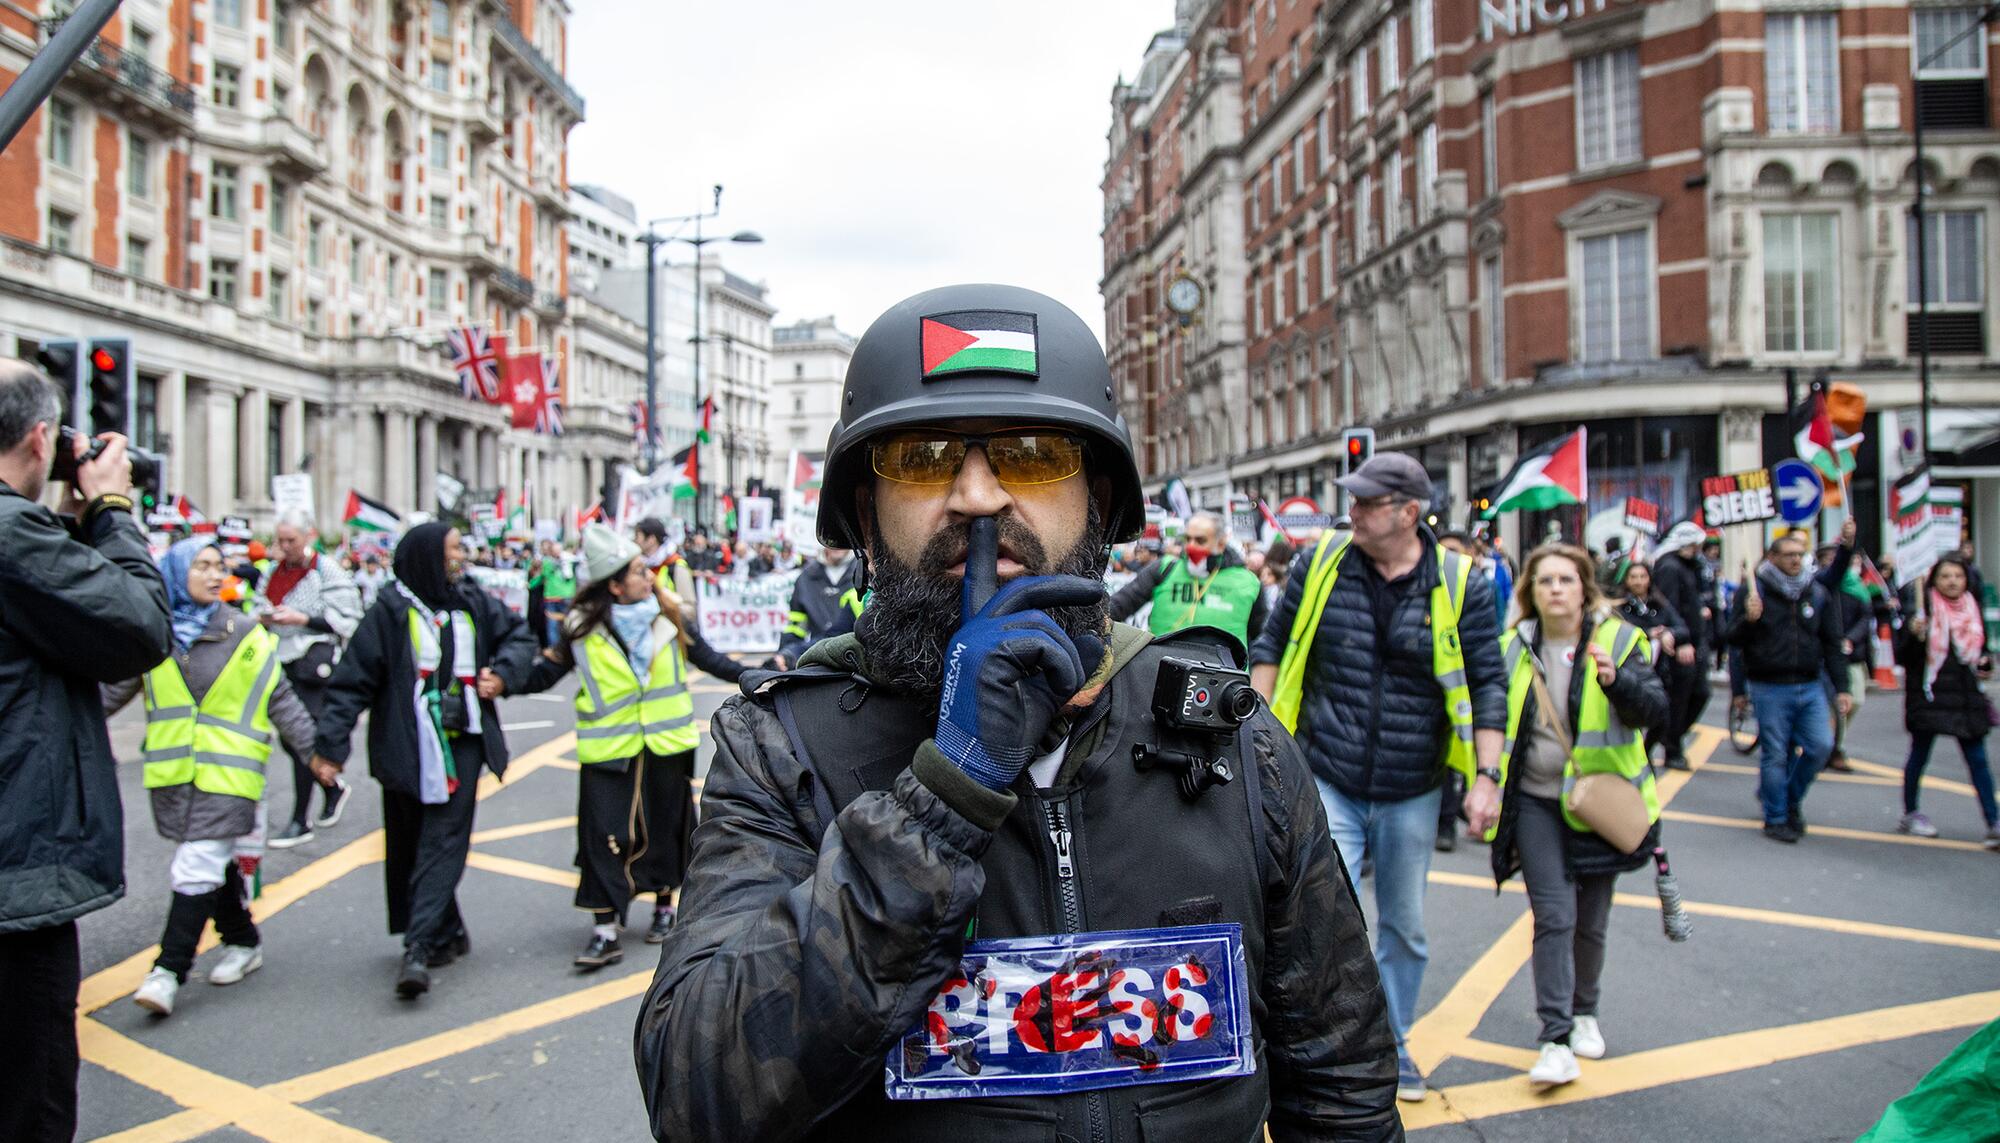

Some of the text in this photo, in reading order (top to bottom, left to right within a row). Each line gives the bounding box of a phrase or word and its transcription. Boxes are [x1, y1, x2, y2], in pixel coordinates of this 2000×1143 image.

[1702, 468, 1770, 497] END THE
[1703, 486, 1776, 526] SIEGE
[706, 609, 760, 628] STOP
[928, 963, 1212, 1056] PRESS
